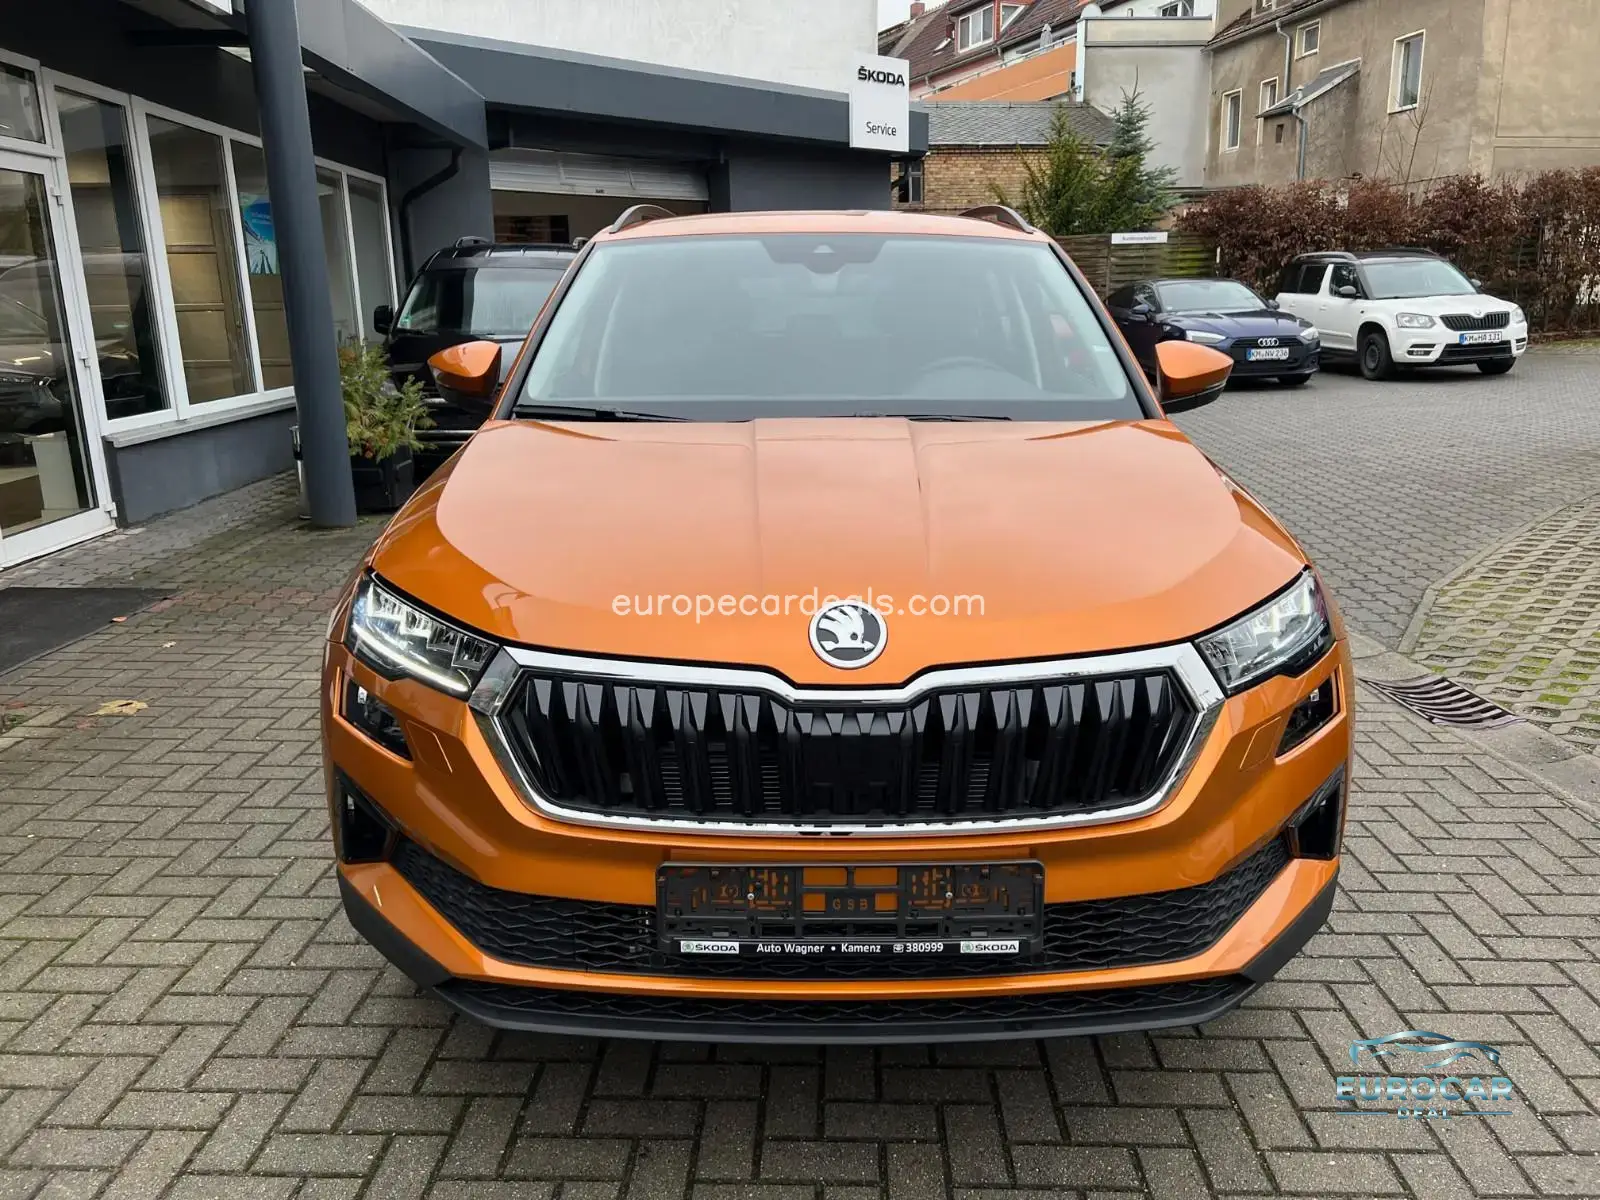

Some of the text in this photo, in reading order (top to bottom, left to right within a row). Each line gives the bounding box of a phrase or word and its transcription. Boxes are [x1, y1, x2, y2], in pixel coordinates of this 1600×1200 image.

[857, 65, 905, 87] ŠKODA
[866, 121, 897, 136] Service
[695, 942, 1017, 955] ŠKODA Auto Wagner Kamenz 380999 ŠKODA
